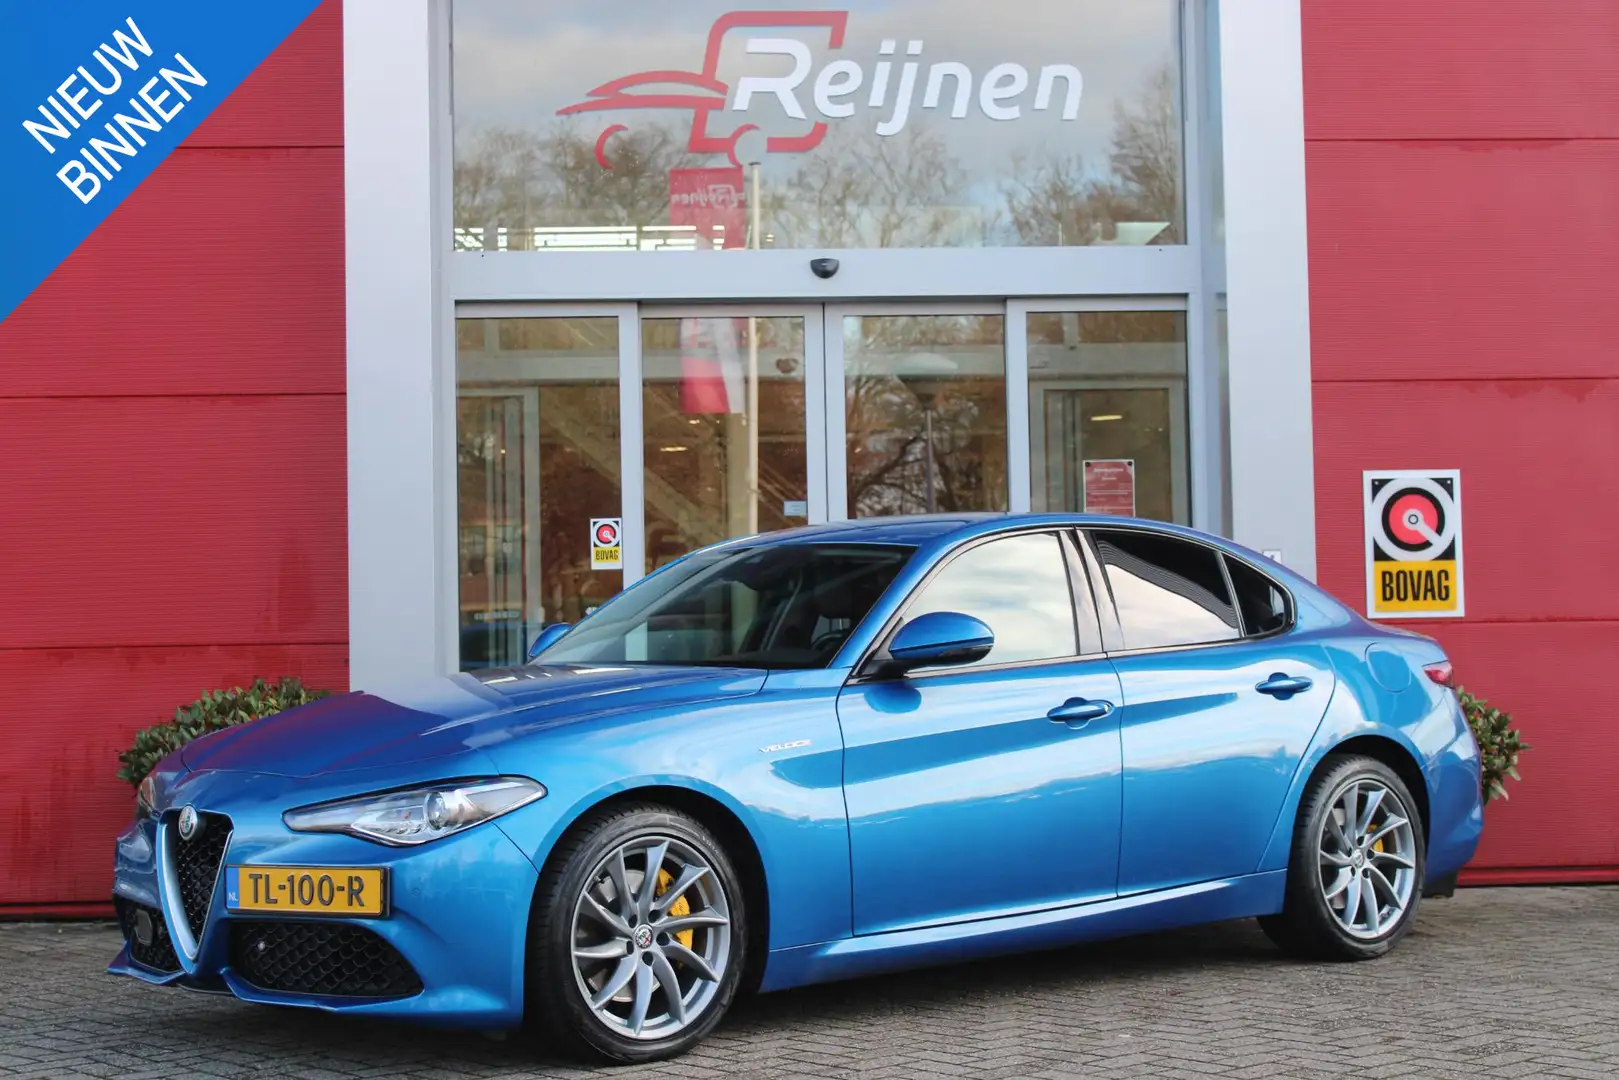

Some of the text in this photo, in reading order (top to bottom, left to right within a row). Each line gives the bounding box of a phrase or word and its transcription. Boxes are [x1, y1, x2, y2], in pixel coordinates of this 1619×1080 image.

[732, 38, 1083, 136] Reijnen
[595, 549, 619, 561] BOVAG
[1381, 569, 1450, 602] BOVAG
[228, 873, 366, 907] NL TL-100-R
